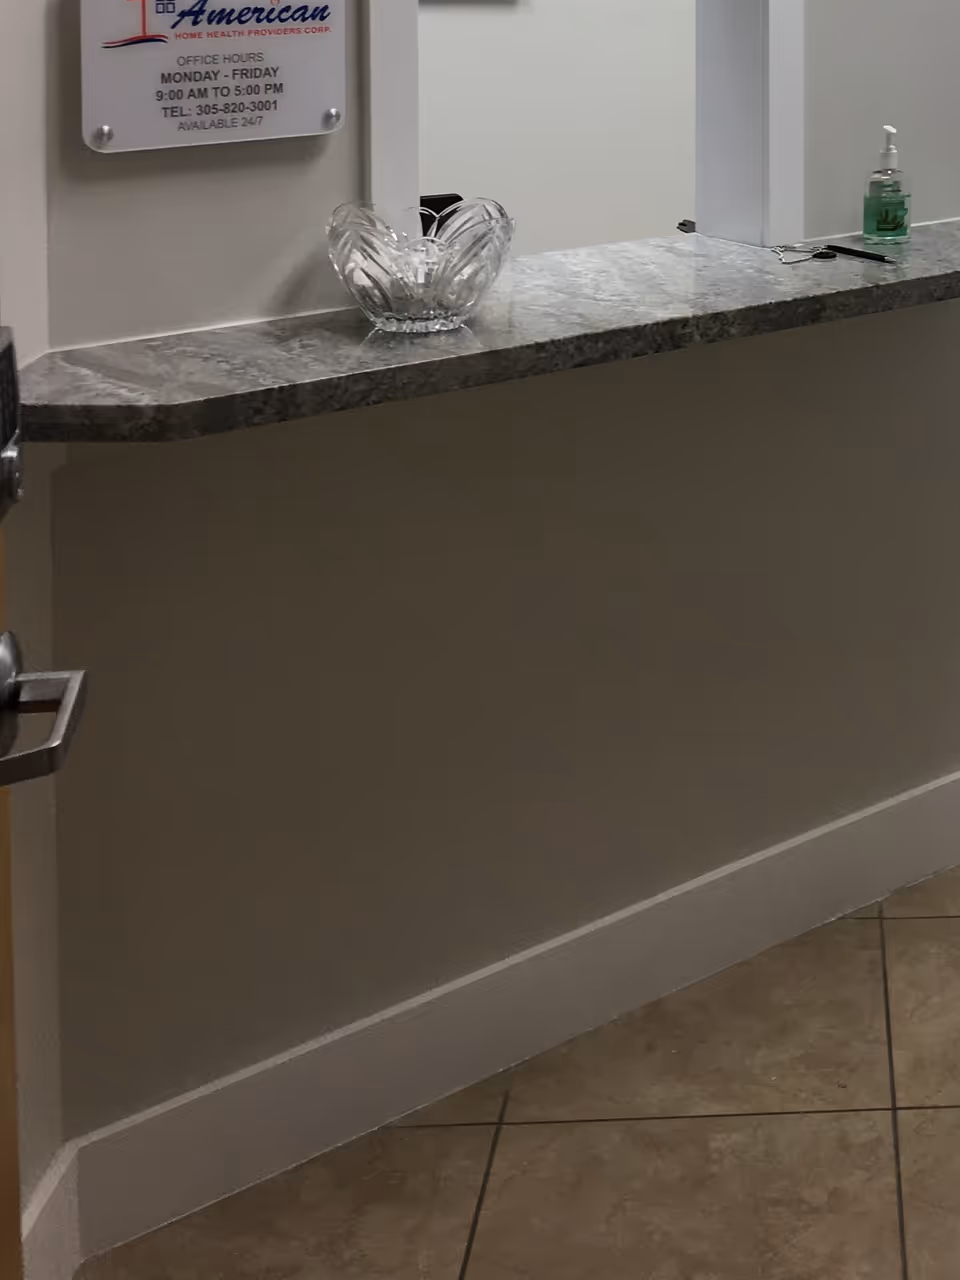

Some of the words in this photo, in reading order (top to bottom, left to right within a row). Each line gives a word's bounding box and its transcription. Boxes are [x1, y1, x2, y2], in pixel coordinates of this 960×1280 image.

[175, 31, 203, 40] HOME
[207, 29, 245, 39] HEALTH
[248, 27, 302, 37] PROVIDERS
[304, 26, 332, 35] CORP.
[177, 54, 219, 67] OFFICE
[223, 52, 264, 64] HOURS
[161, 70, 220, 84] MONDAY
[232, 67, 279, 80] FRIDAY
[156, 90, 183, 101] 9:00
[187, 88, 208, 99] AM
[212, 86, 230, 97] TO
[234, 84, 260, 96] 5:00
[264, 83, 284, 94] PM
[162, 106, 192, 118] TEL:
[196, 100, 278, 115] 305-820-3001
[177, 118, 239, 131] AVAILABLE
[241, 116, 263, 127] 24/7
